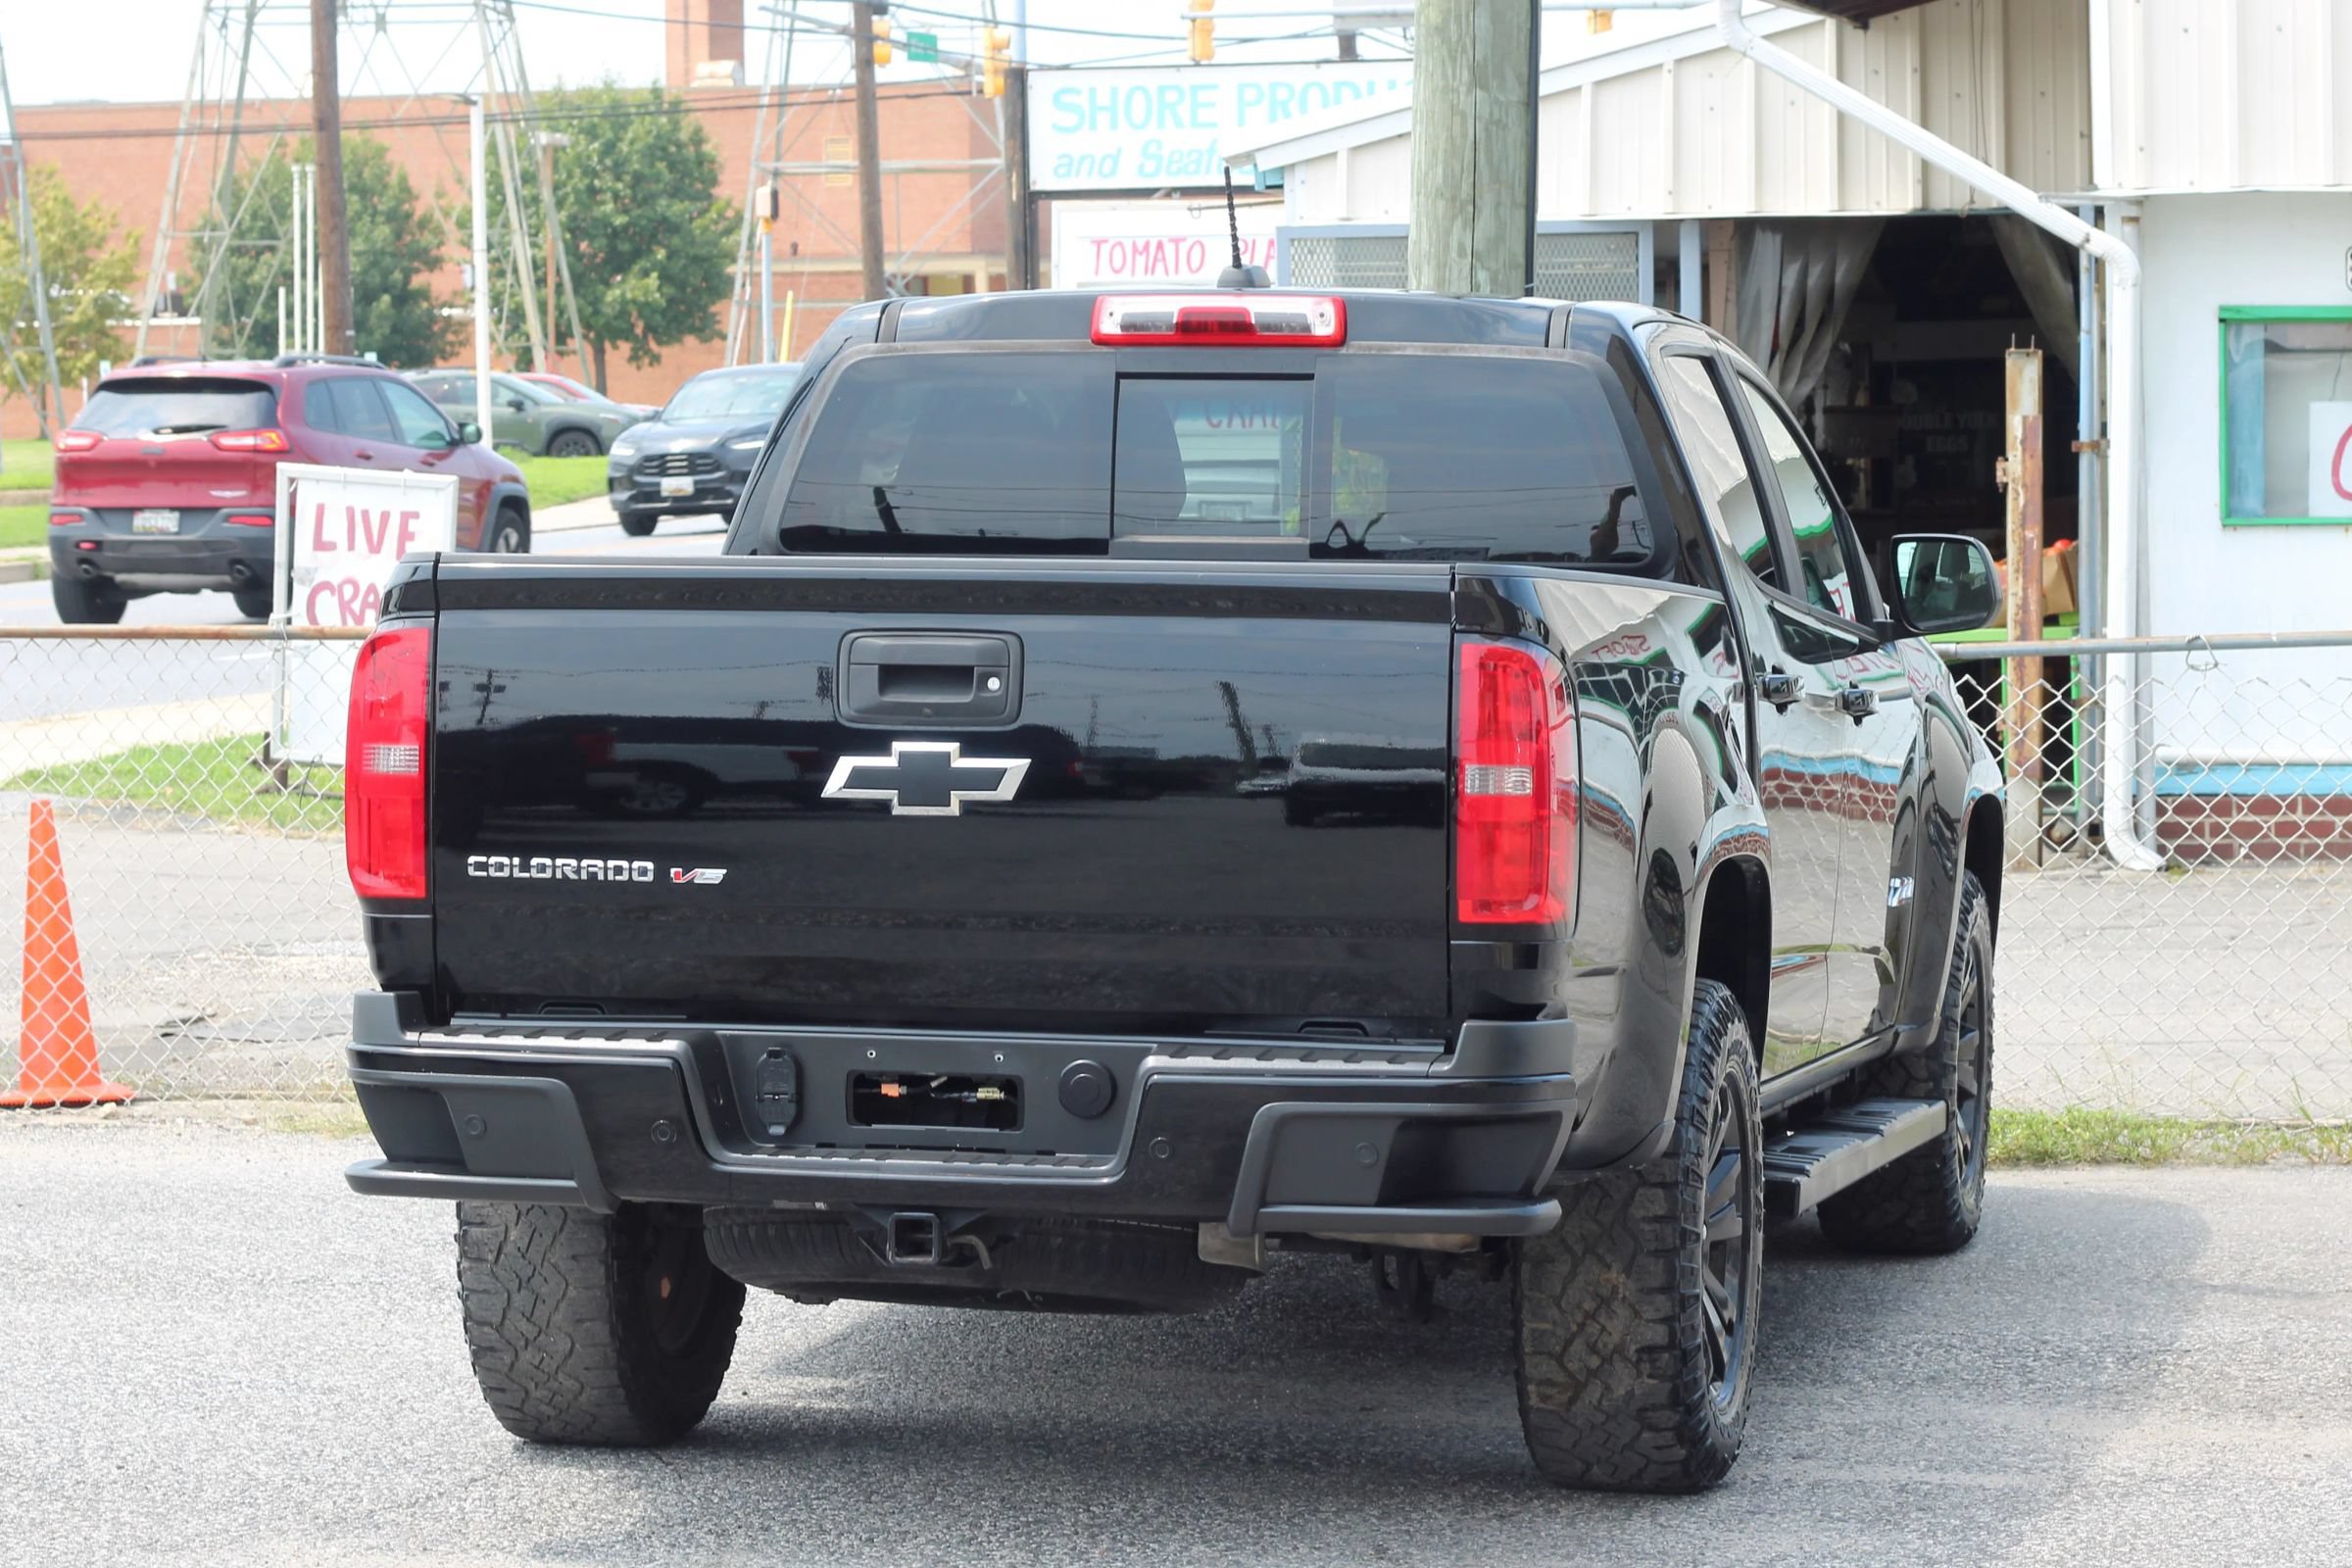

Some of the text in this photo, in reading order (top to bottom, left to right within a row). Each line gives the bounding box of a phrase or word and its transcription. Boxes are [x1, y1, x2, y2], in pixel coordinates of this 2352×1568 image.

[1051, 82, 1220, 134] SHORE
[1053, 146, 1122, 178] and
[1090, 236, 1206, 277] TOMATO
[312, 502, 420, 563] LIVE
[466, 855, 728, 884] COLORADO V6
